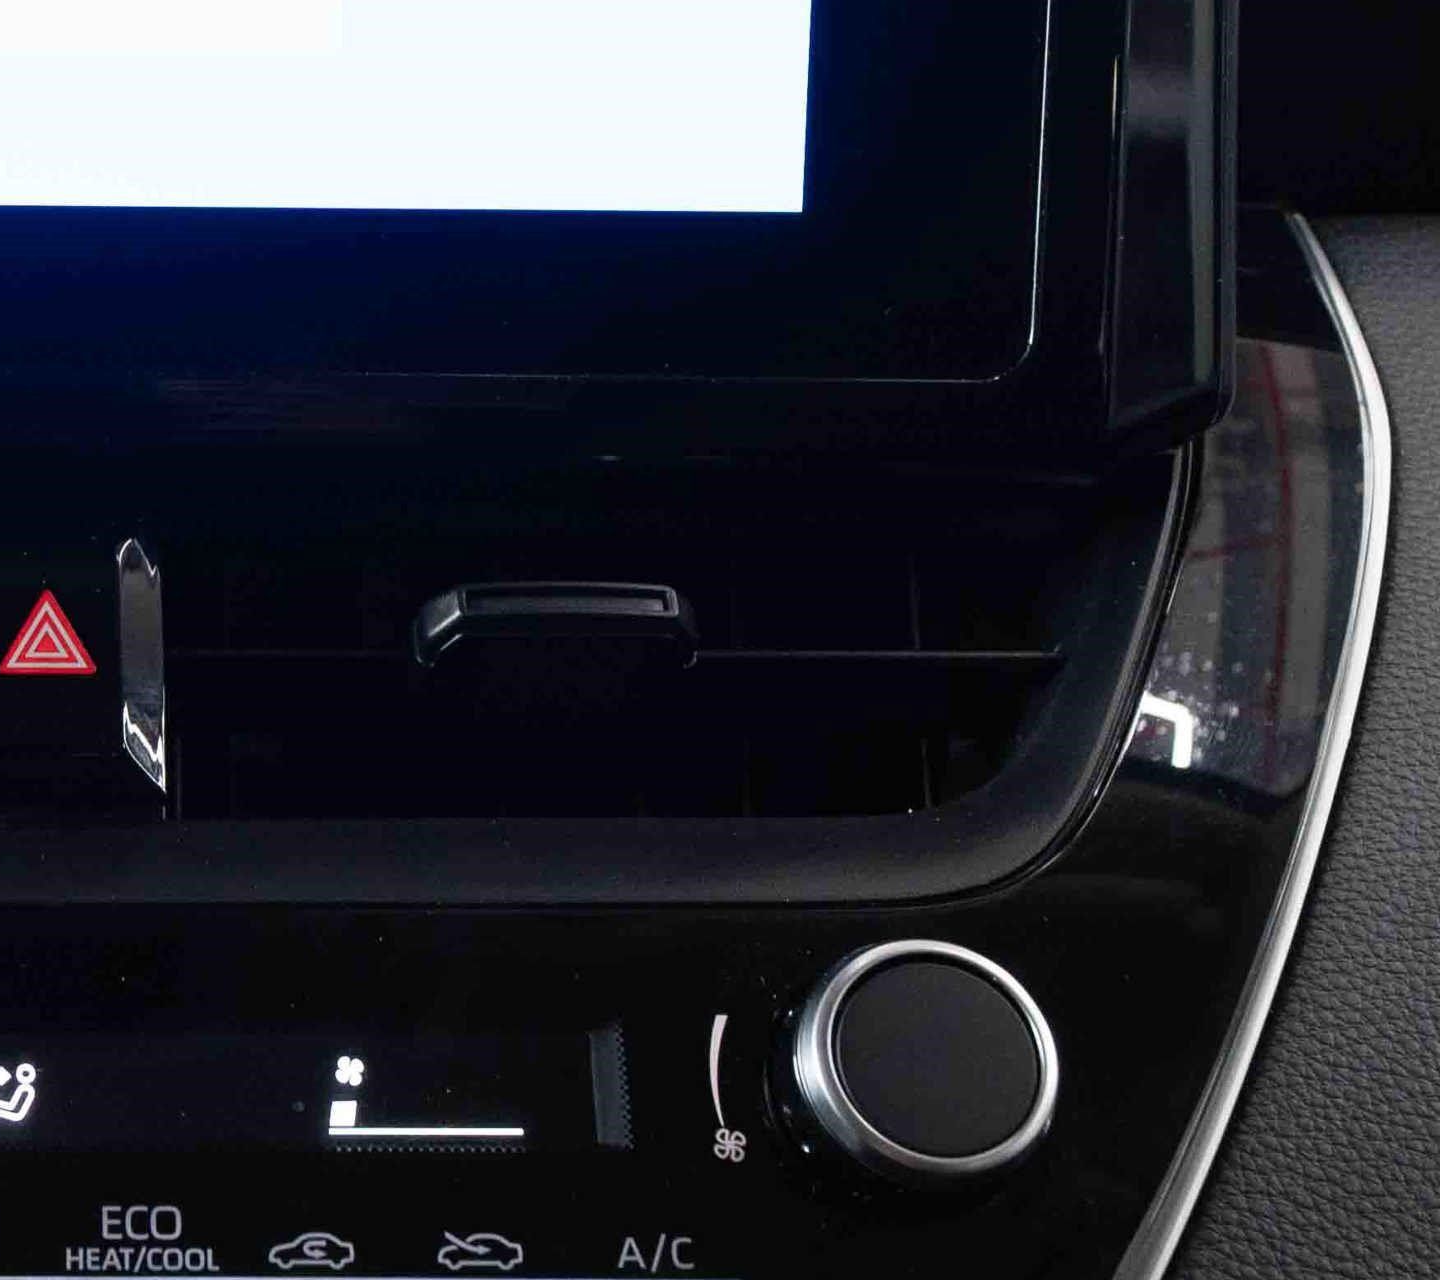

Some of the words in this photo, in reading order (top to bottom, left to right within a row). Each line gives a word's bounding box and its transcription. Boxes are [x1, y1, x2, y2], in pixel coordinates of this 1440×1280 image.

[100, 1204, 182, 1240] ECO
[64, 1246, 220, 1272] HEAT/COOL
[617, 1235, 693, 1271] A/C
